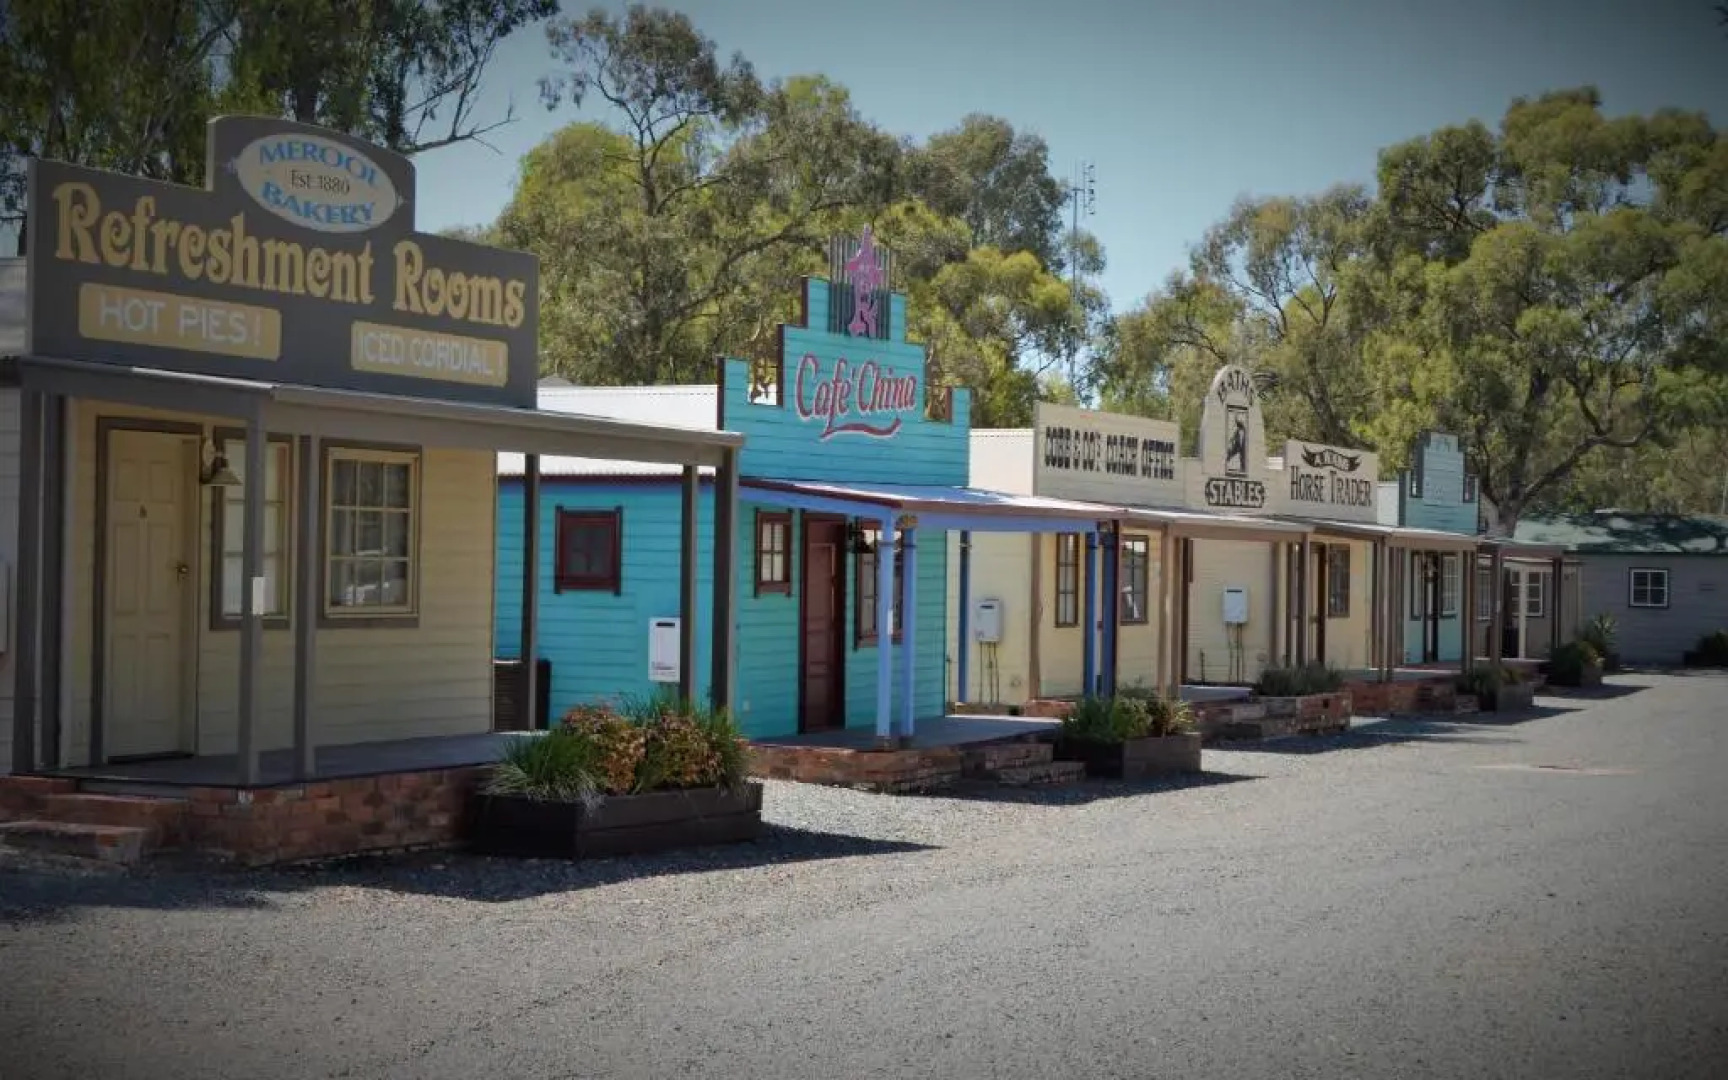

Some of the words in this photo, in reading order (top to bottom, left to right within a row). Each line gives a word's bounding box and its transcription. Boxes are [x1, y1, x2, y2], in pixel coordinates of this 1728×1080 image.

[262, 181, 375, 224] BAKERY
[53, 182, 374, 305] Refreshment
[393, 240, 525, 328] Rooms
[101, 289, 165, 335] HOT
[359, 329, 405, 365] ICED
[857, 361, 917, 413] China
[1208, 480, 1262, 507] STABLES
